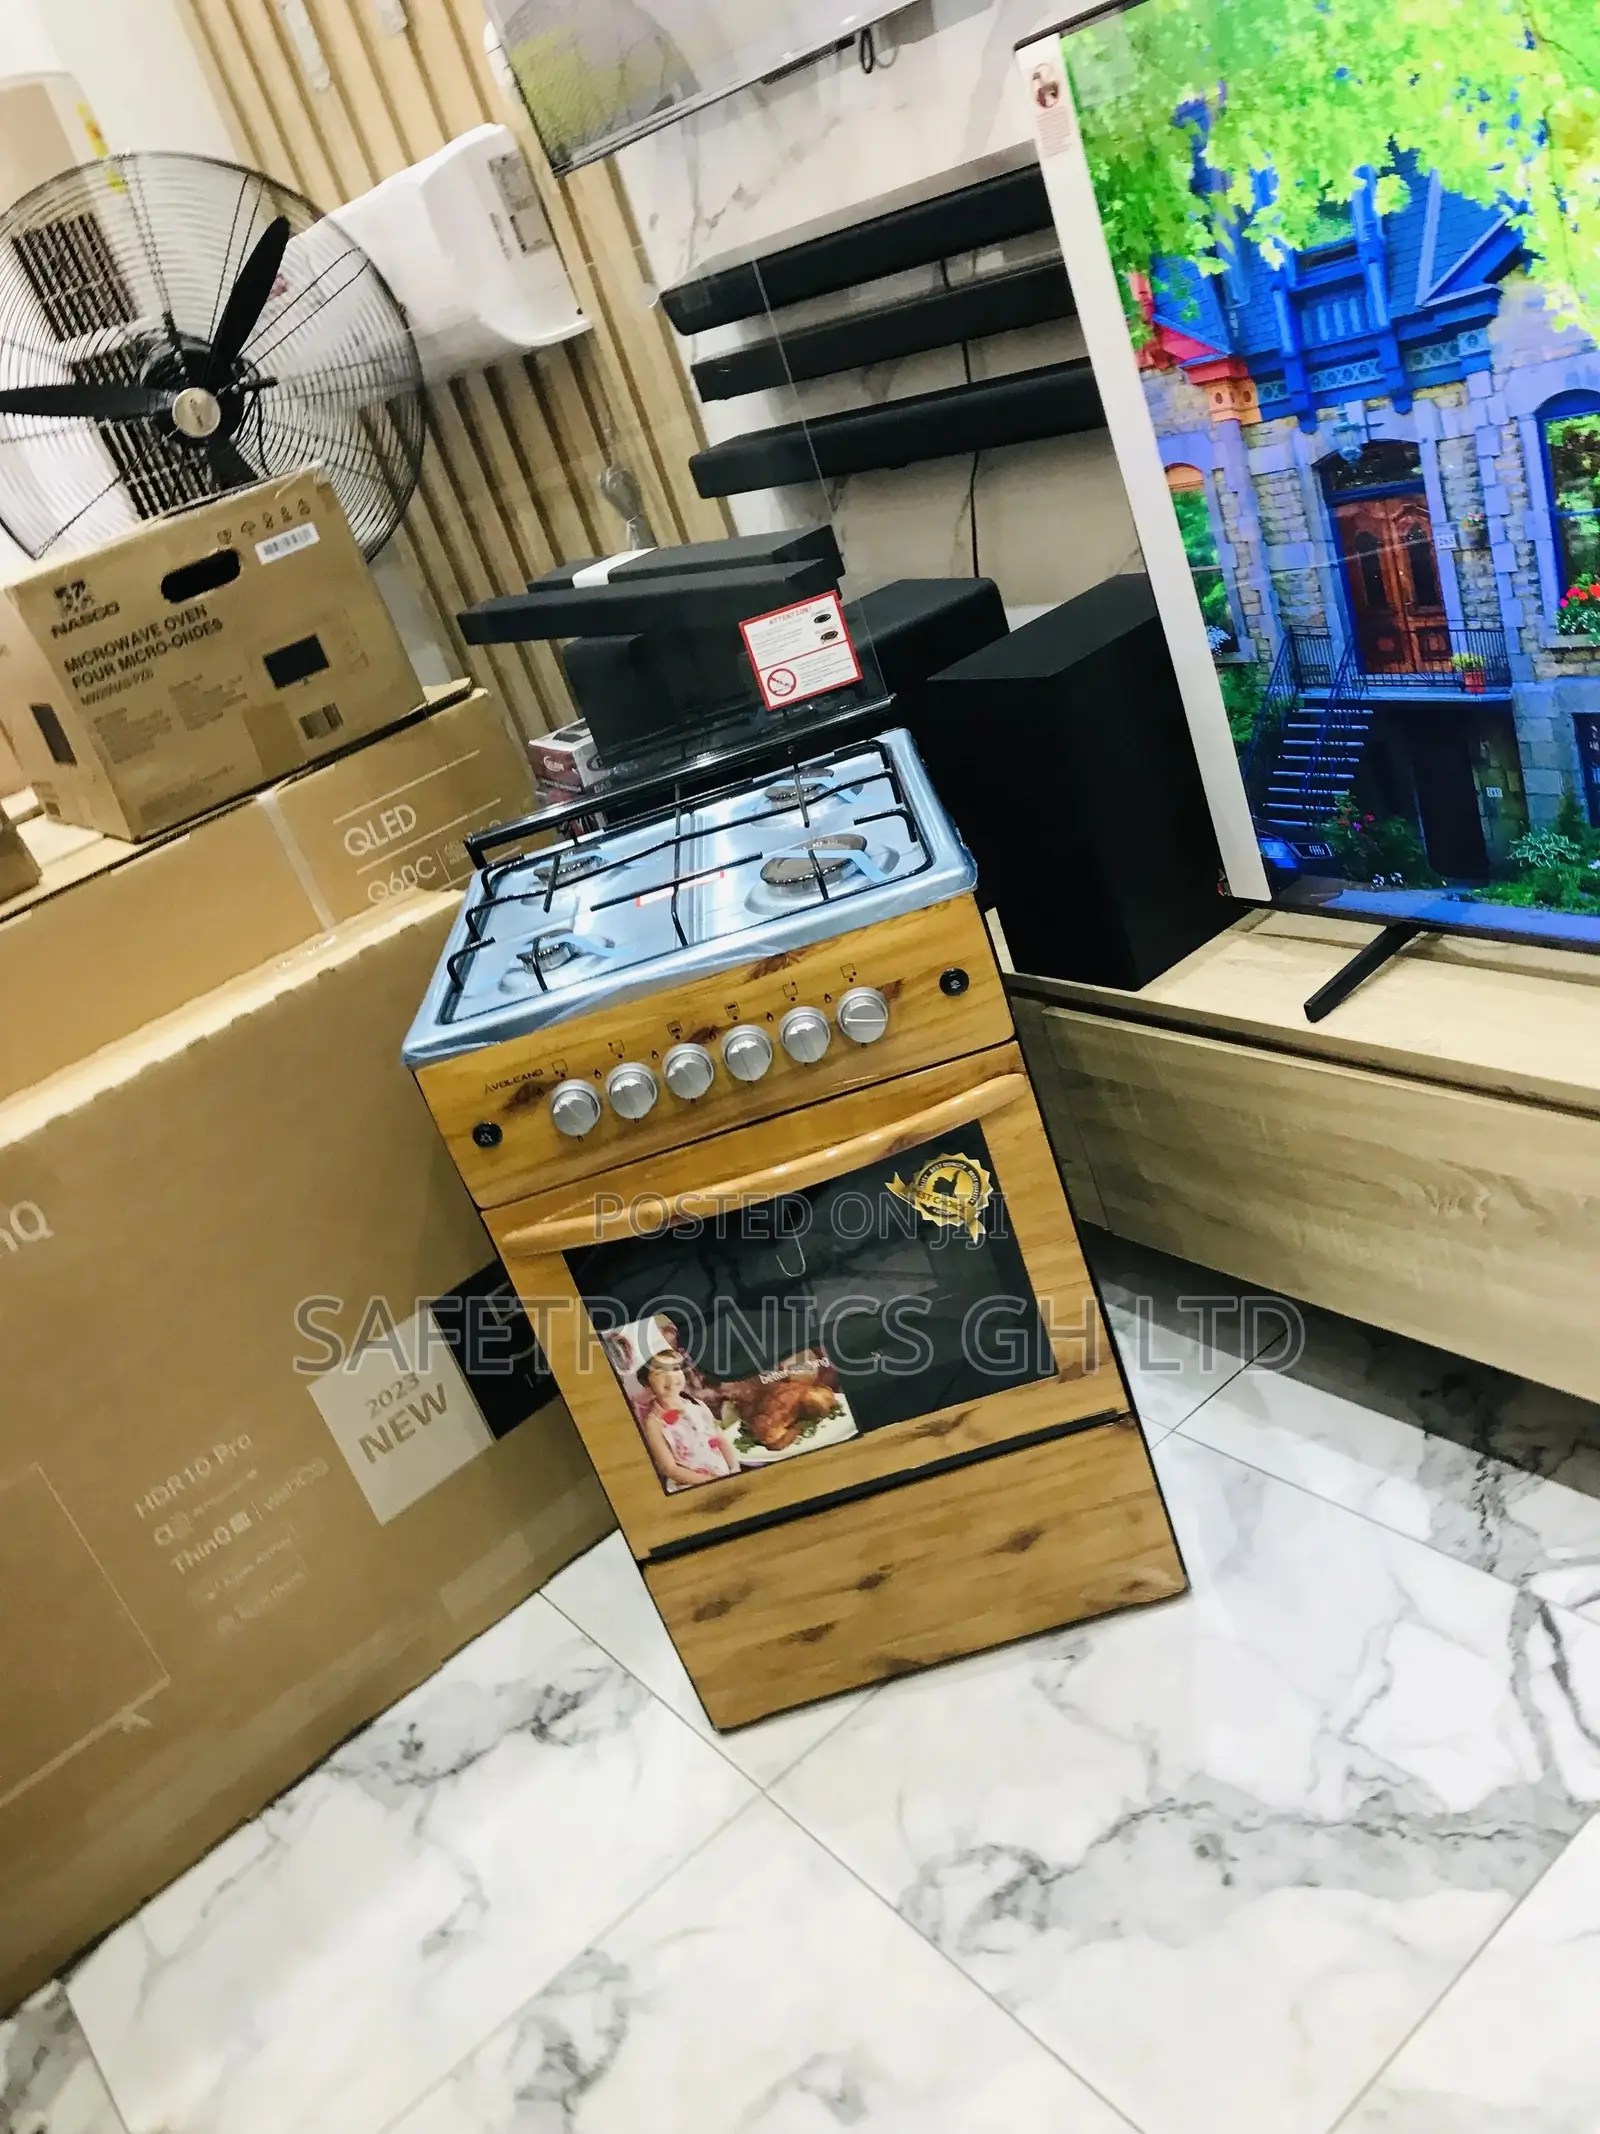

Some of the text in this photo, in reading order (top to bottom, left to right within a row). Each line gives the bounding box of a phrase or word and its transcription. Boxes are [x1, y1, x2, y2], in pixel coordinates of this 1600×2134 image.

[51, 601, 120, 639] NASCO
[64, 604, 208, 674] MICROWAVE OVEN
[72, 661, 117, 690] FOUR
[118, 617, 223, 673] MICRO-ONDES
[344, 804, 417, 857] QLED
[367, 855, 437, 903] Q60C
[491, 1068, 544, 1091] VOLCANO
[364, 1371, 420, 1420] 2023
[358, 1382, 448, 1464] NEW
[212, 1433, 252, 1465] Pro
[170, 1526, 233, 1576] ThinQ
